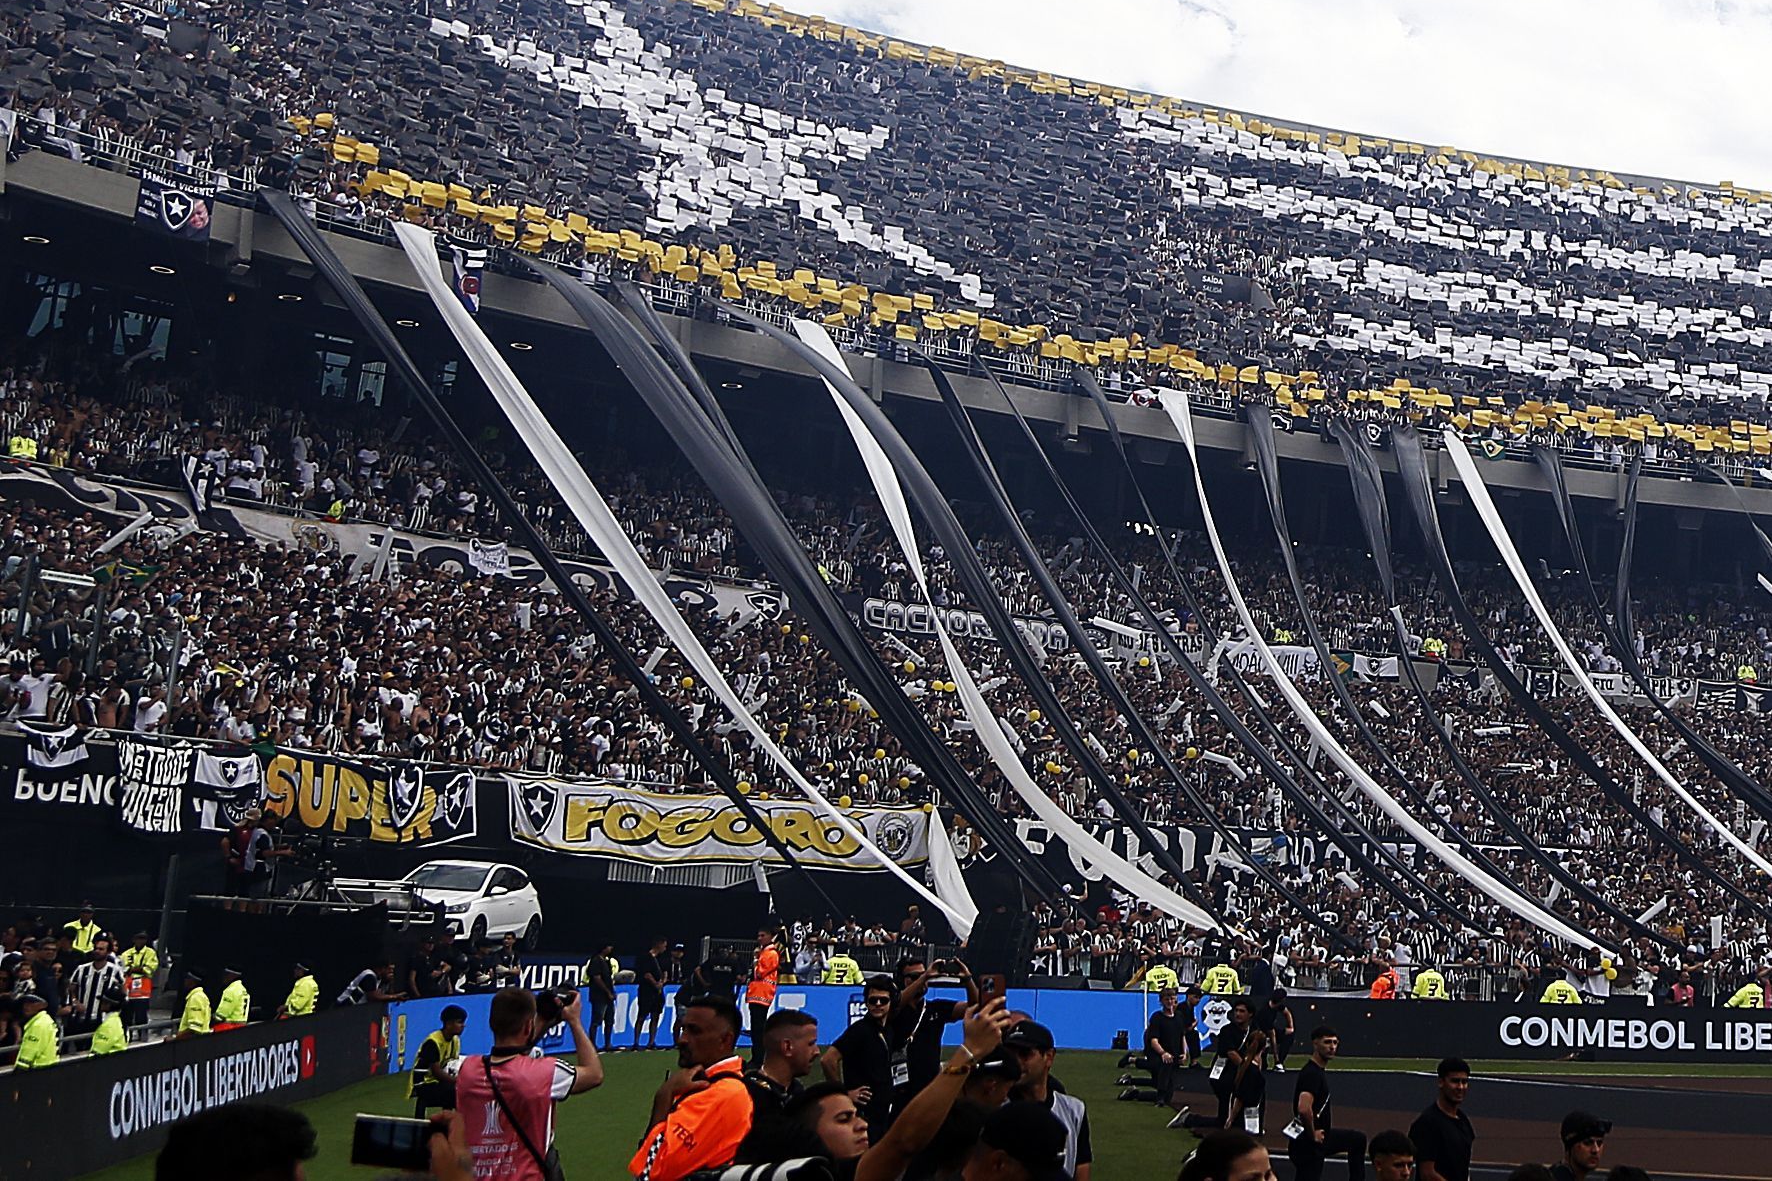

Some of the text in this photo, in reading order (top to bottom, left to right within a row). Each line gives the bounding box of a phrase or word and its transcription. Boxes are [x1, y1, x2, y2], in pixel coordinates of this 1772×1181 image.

[1202, 275, 1224, 285] SAÍDA
[863, 597, 1071, 651] CACHORDA
[1499, 1015, 1697, 1051] CONMEBOL
[109, 1038, 300, 1140] CONMEBOL LIBERTADORES
[672, 1122, 698, 1151] TECH
